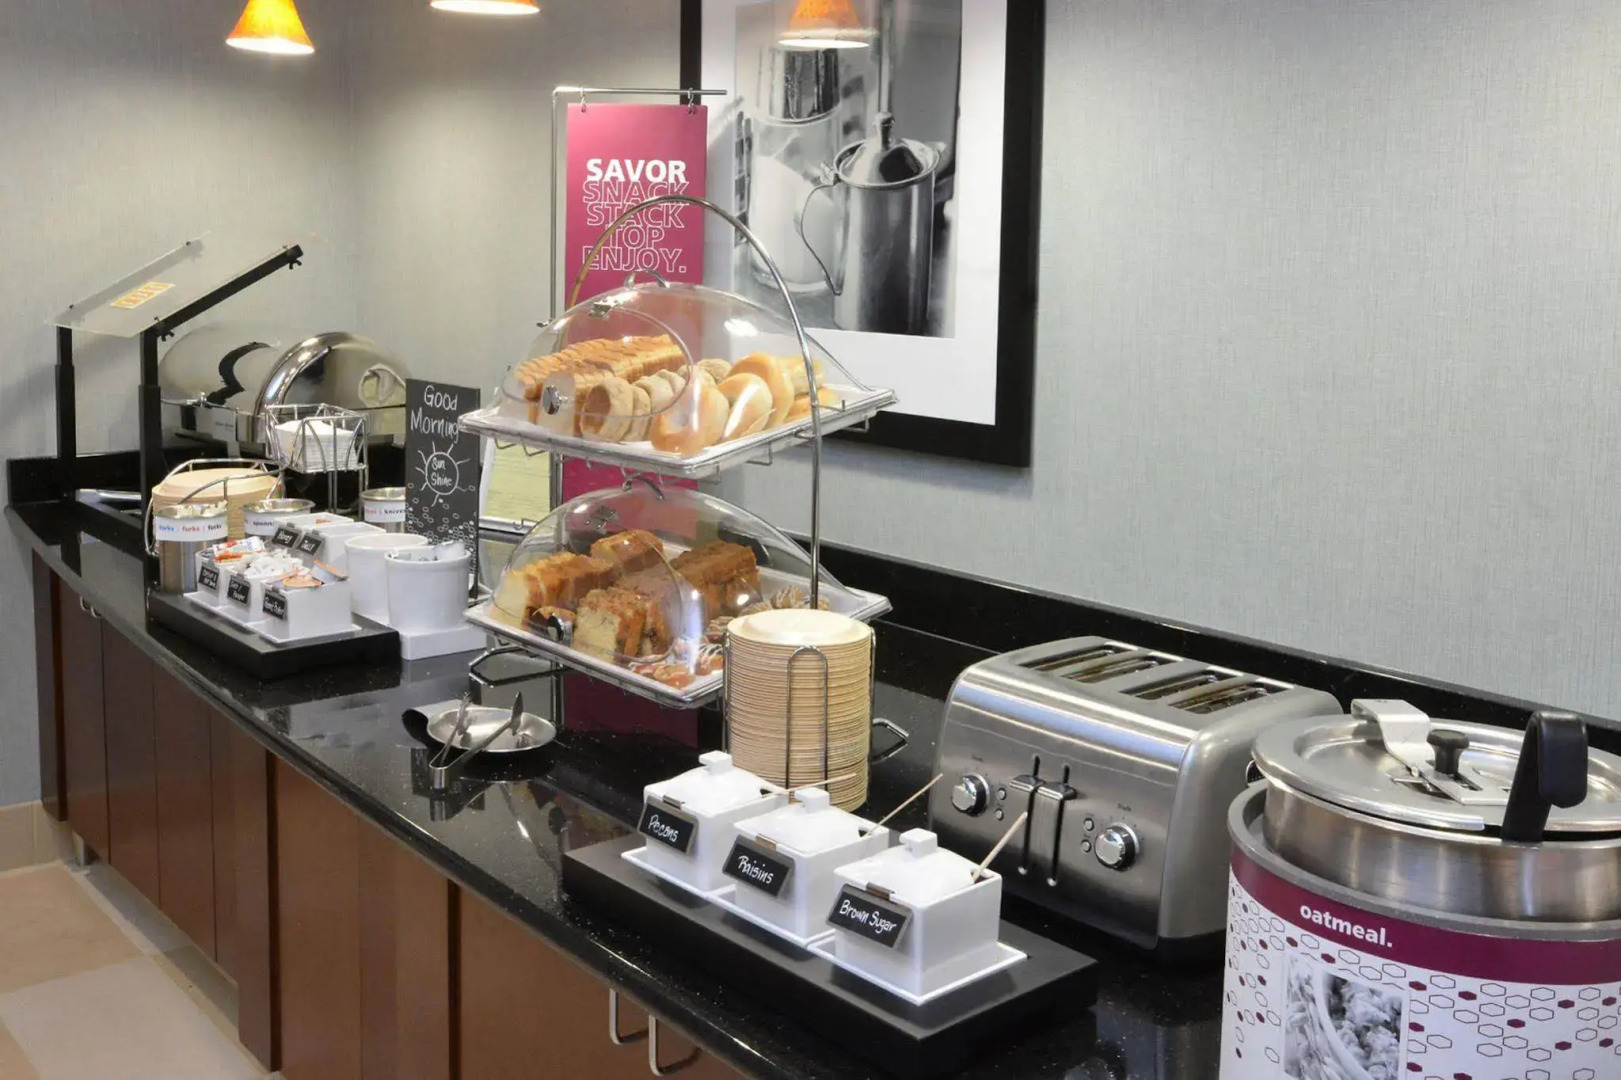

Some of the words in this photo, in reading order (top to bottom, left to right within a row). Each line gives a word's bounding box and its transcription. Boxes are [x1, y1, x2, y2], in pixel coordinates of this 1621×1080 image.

[586, 158, 687, 183] SAVOR
[582, 180, 689, 206] SNACK
[586, 202, 685, 228] STACK
[605, 223, 665, 249] TOP
[582, 245, 687, 273] ENJOY.
[423, 384, 458, 411] Good
[410, 407, 460, 444] Morning
[431, 457, 447, 471] Sun
[430, 473, 453, 487] Shine
[738, 854, 774, 885] Raisins
[839, 899, 869, 924] Brown
[868, 912, 898, 935] Sugar
[1299, 904, 1394, 948] oatmeal.
